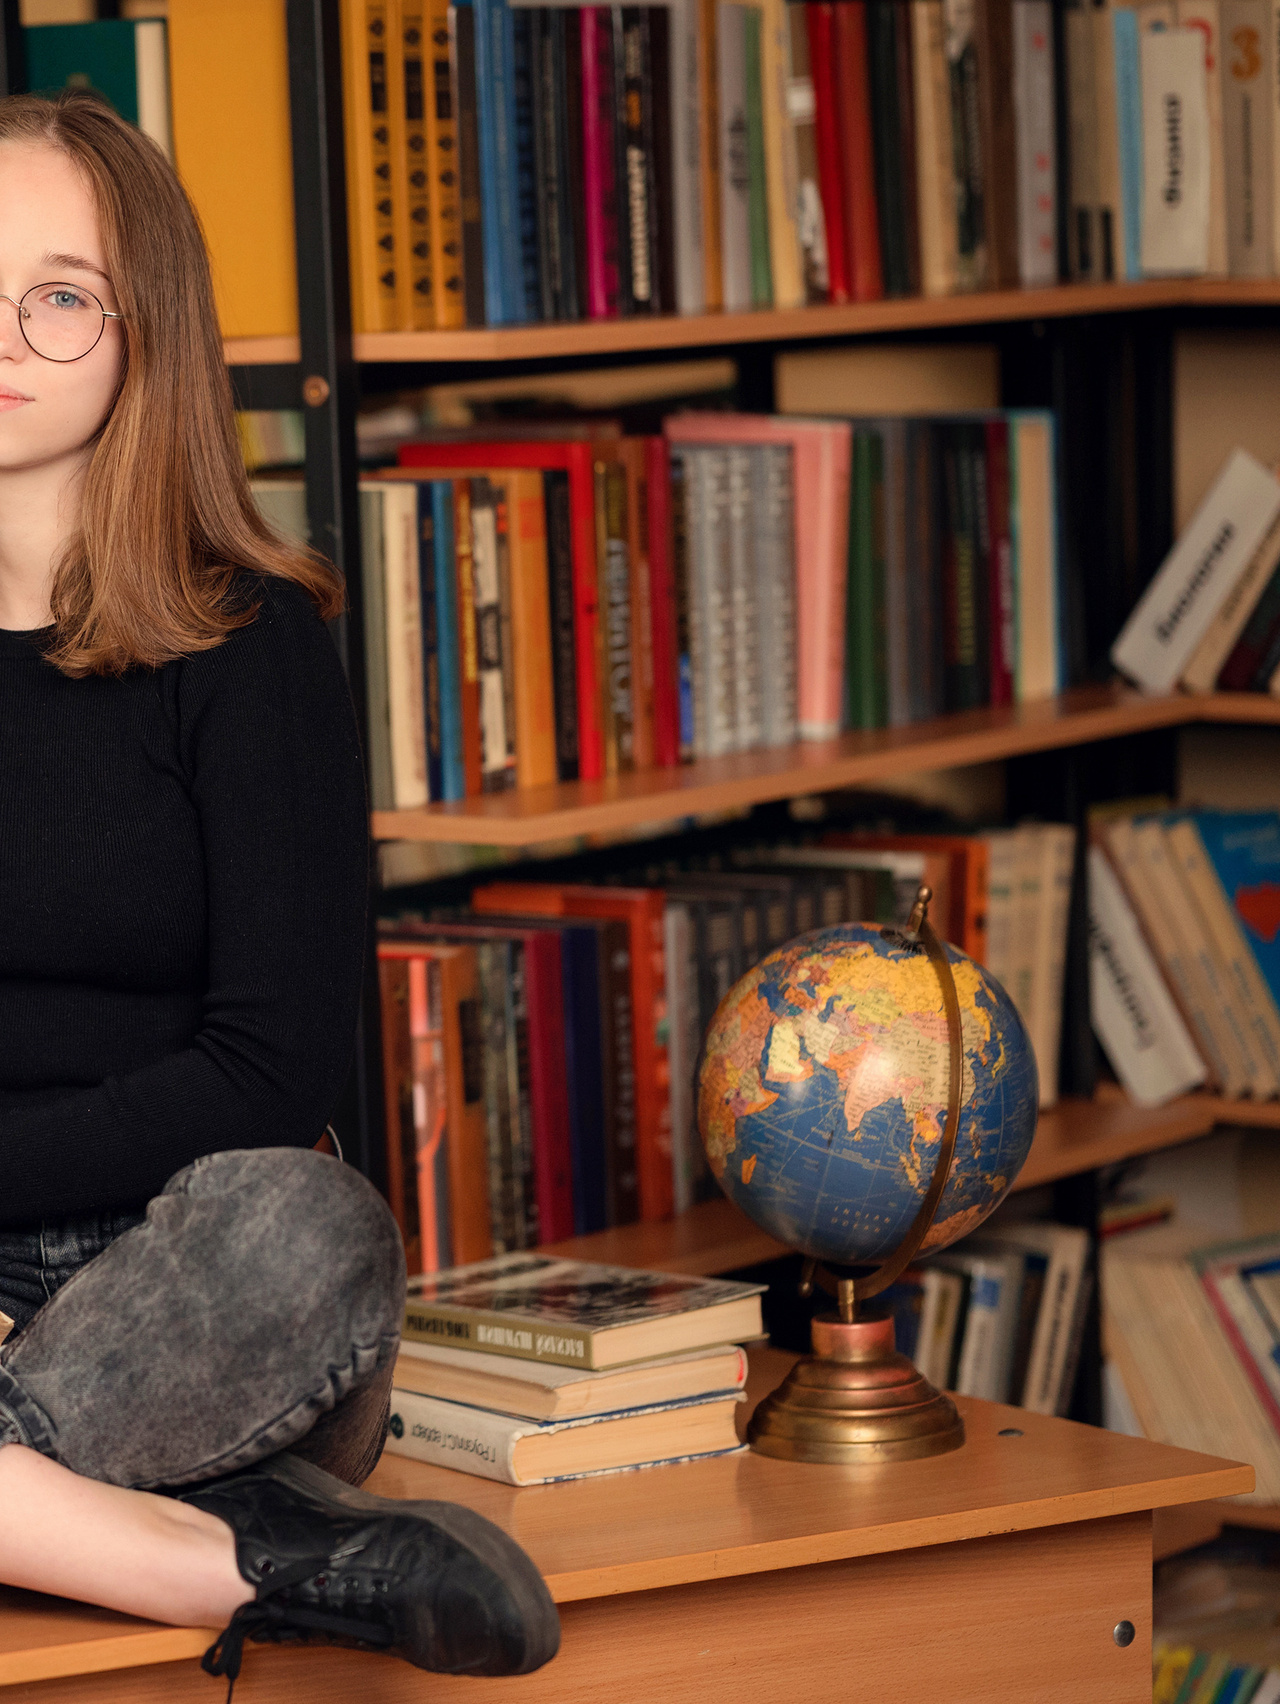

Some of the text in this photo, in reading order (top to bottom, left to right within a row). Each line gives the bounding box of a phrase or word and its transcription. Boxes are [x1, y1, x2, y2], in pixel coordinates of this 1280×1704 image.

[1231, 25, 1261, 81] 3
[477, 1324, 533, 1350] ШУКШИН
[536, 1333, 584, 1359] ВАСИЛИЙ
